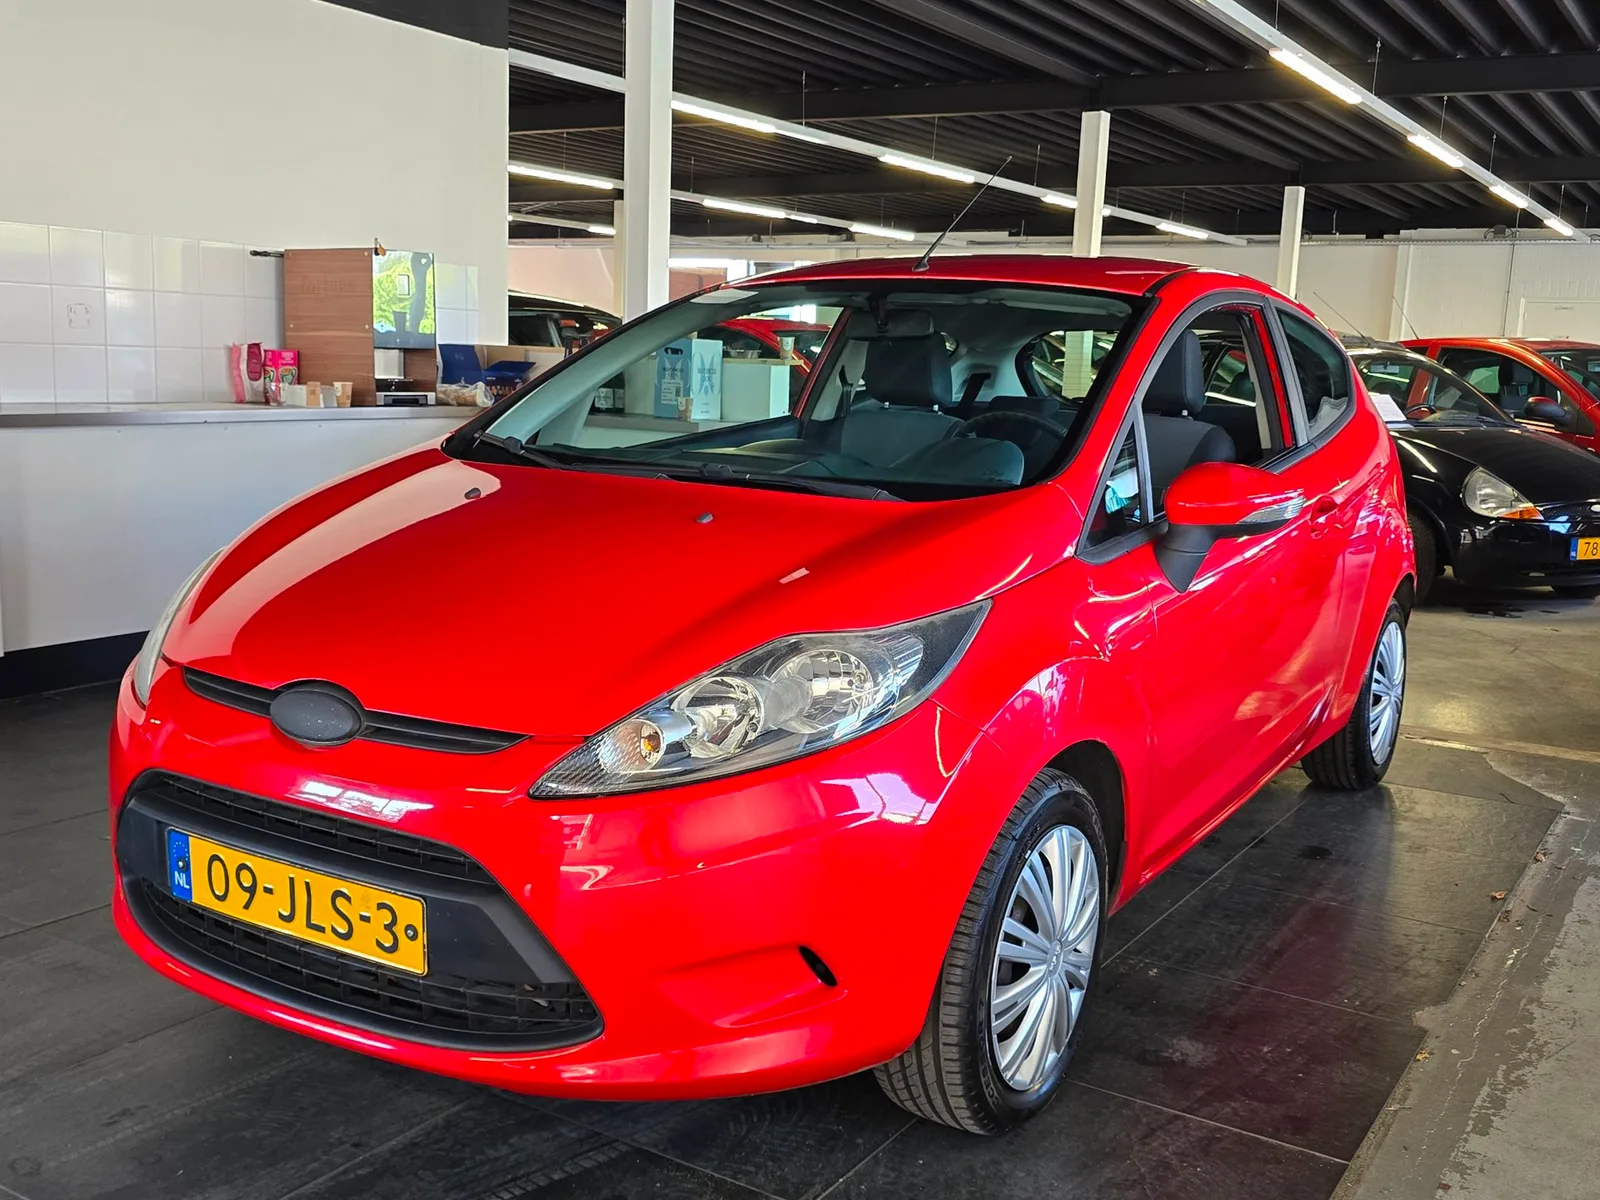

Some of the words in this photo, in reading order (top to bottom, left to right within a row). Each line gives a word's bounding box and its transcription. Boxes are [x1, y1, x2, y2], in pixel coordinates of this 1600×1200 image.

[1584, 541, 1599, 556] 78
[174, 870, 190, 890] NL
[207, 853, 400, 954] 09-JLS-3
